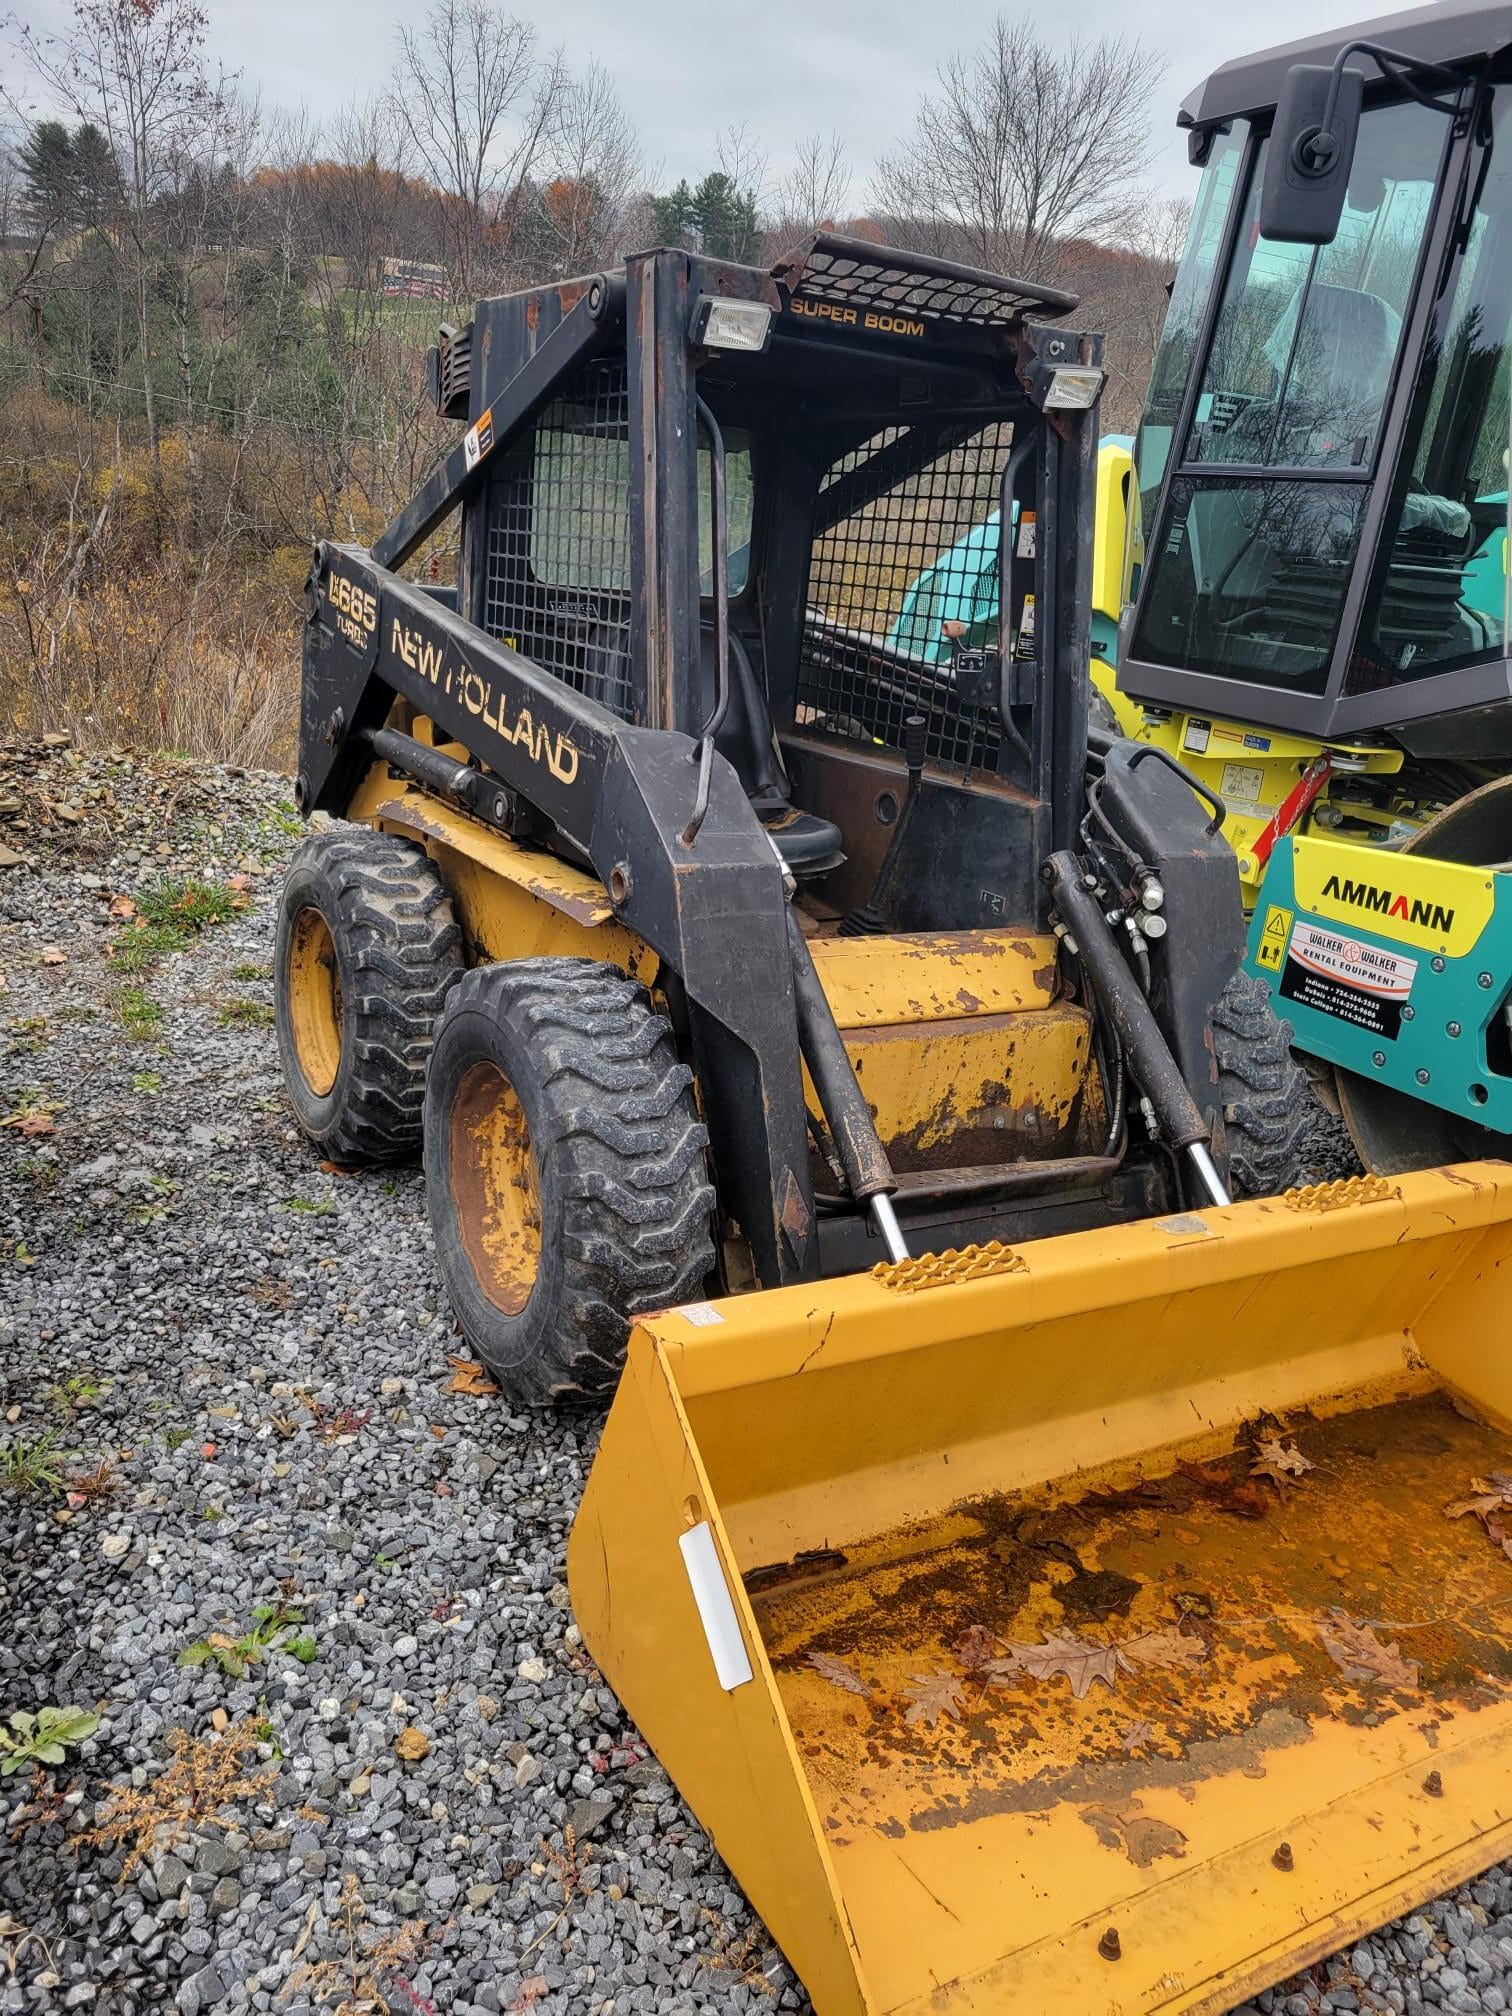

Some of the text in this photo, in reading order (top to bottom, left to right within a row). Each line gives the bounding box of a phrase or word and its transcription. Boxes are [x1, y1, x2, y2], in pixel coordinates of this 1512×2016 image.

[789, 298, 925, 337] SUPER BOOM
[391, 617, 443, 685] NEW
[1321, 875, 1455, 934] AMMANN
[1302, 948, 1396, 988] RENTAL EQUIPMENT
[1309, 932, 1343, 953] WALKER
[1361, 950, 1397, 973] WALKER
[1292, 990, 1310, 1002] State
[1310, 997, 1334, 1012] College
[1305, 976, 1329, 991] Indiana
